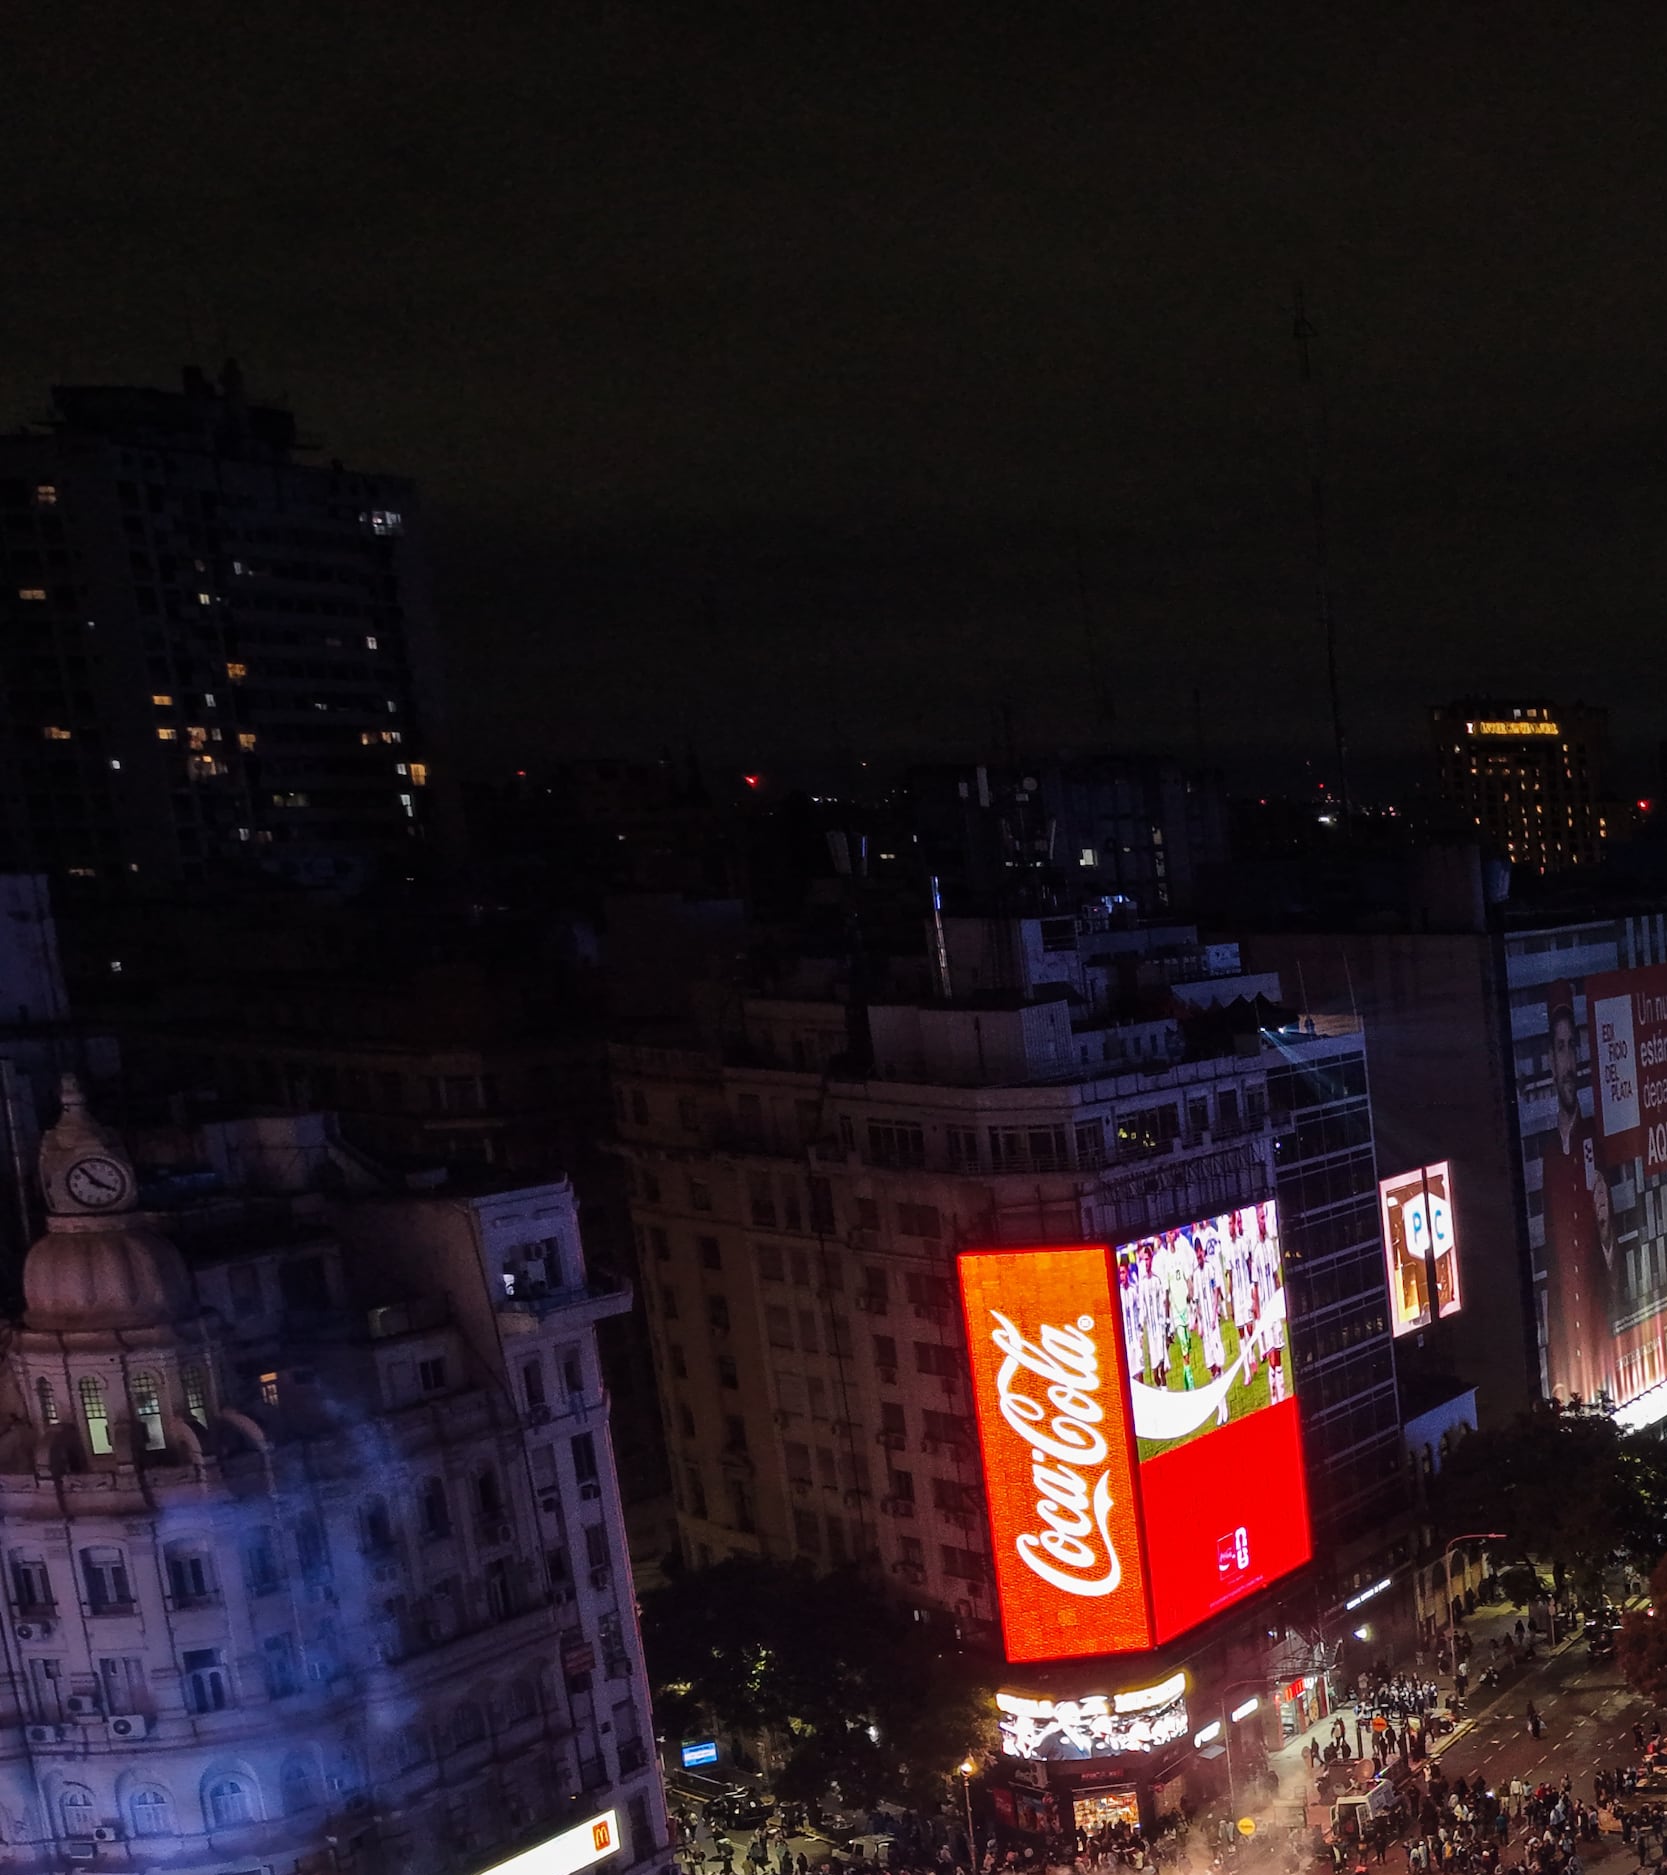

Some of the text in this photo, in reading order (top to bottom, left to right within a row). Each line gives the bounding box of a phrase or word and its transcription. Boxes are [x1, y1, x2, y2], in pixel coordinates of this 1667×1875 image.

[1636, 993, 1652, 1026] Un
[1604, 1065, 1621, 1084] DEL
[1611, 1081, 1633, 1102] PLATA
[990, 1310, 1121, 1597] Coca-Cola
